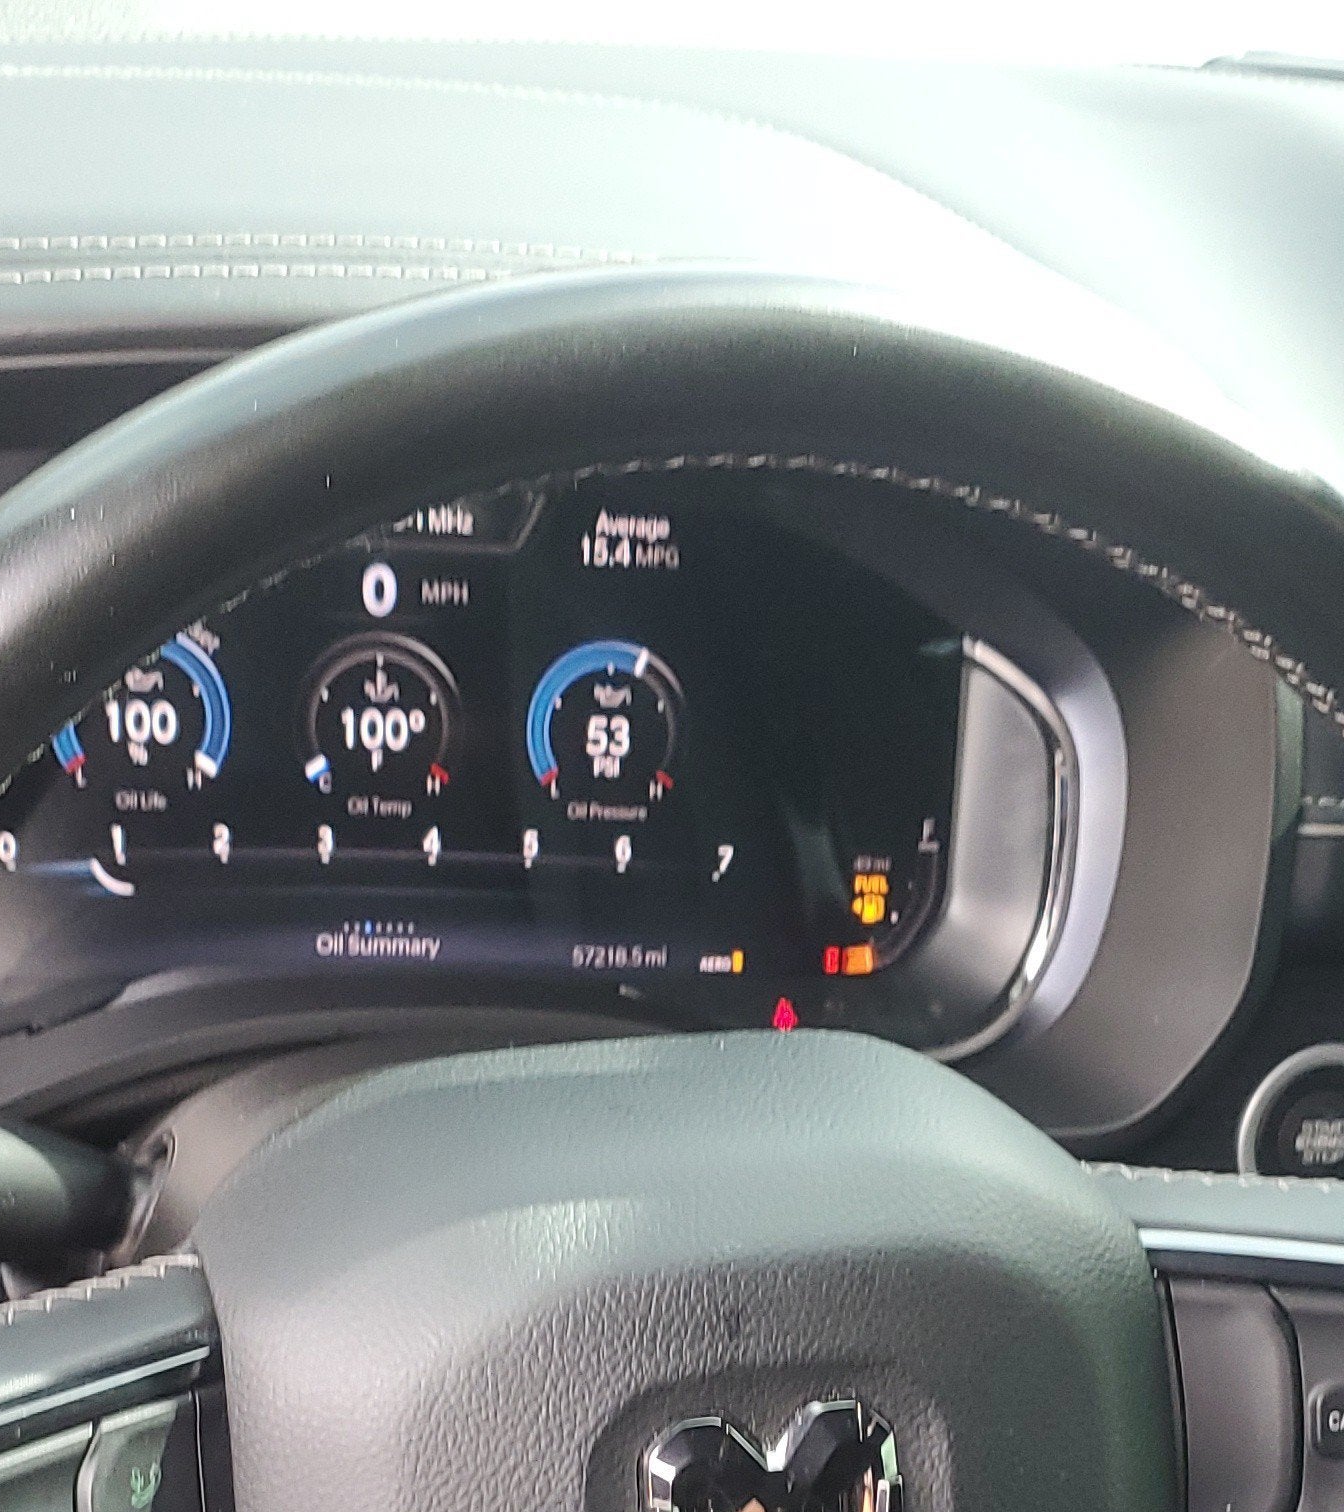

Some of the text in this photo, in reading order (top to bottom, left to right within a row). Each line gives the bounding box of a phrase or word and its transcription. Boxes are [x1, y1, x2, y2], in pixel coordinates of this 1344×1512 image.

[596, 506, 670, 544] Average
[362, 563, 397, 617] 0
[421, 578, 470, 607] MPH
[106, 699, 178, 745] 100
[585, 714, 631, 757] 53
[315, 932, 441, 961] Oil Summary
